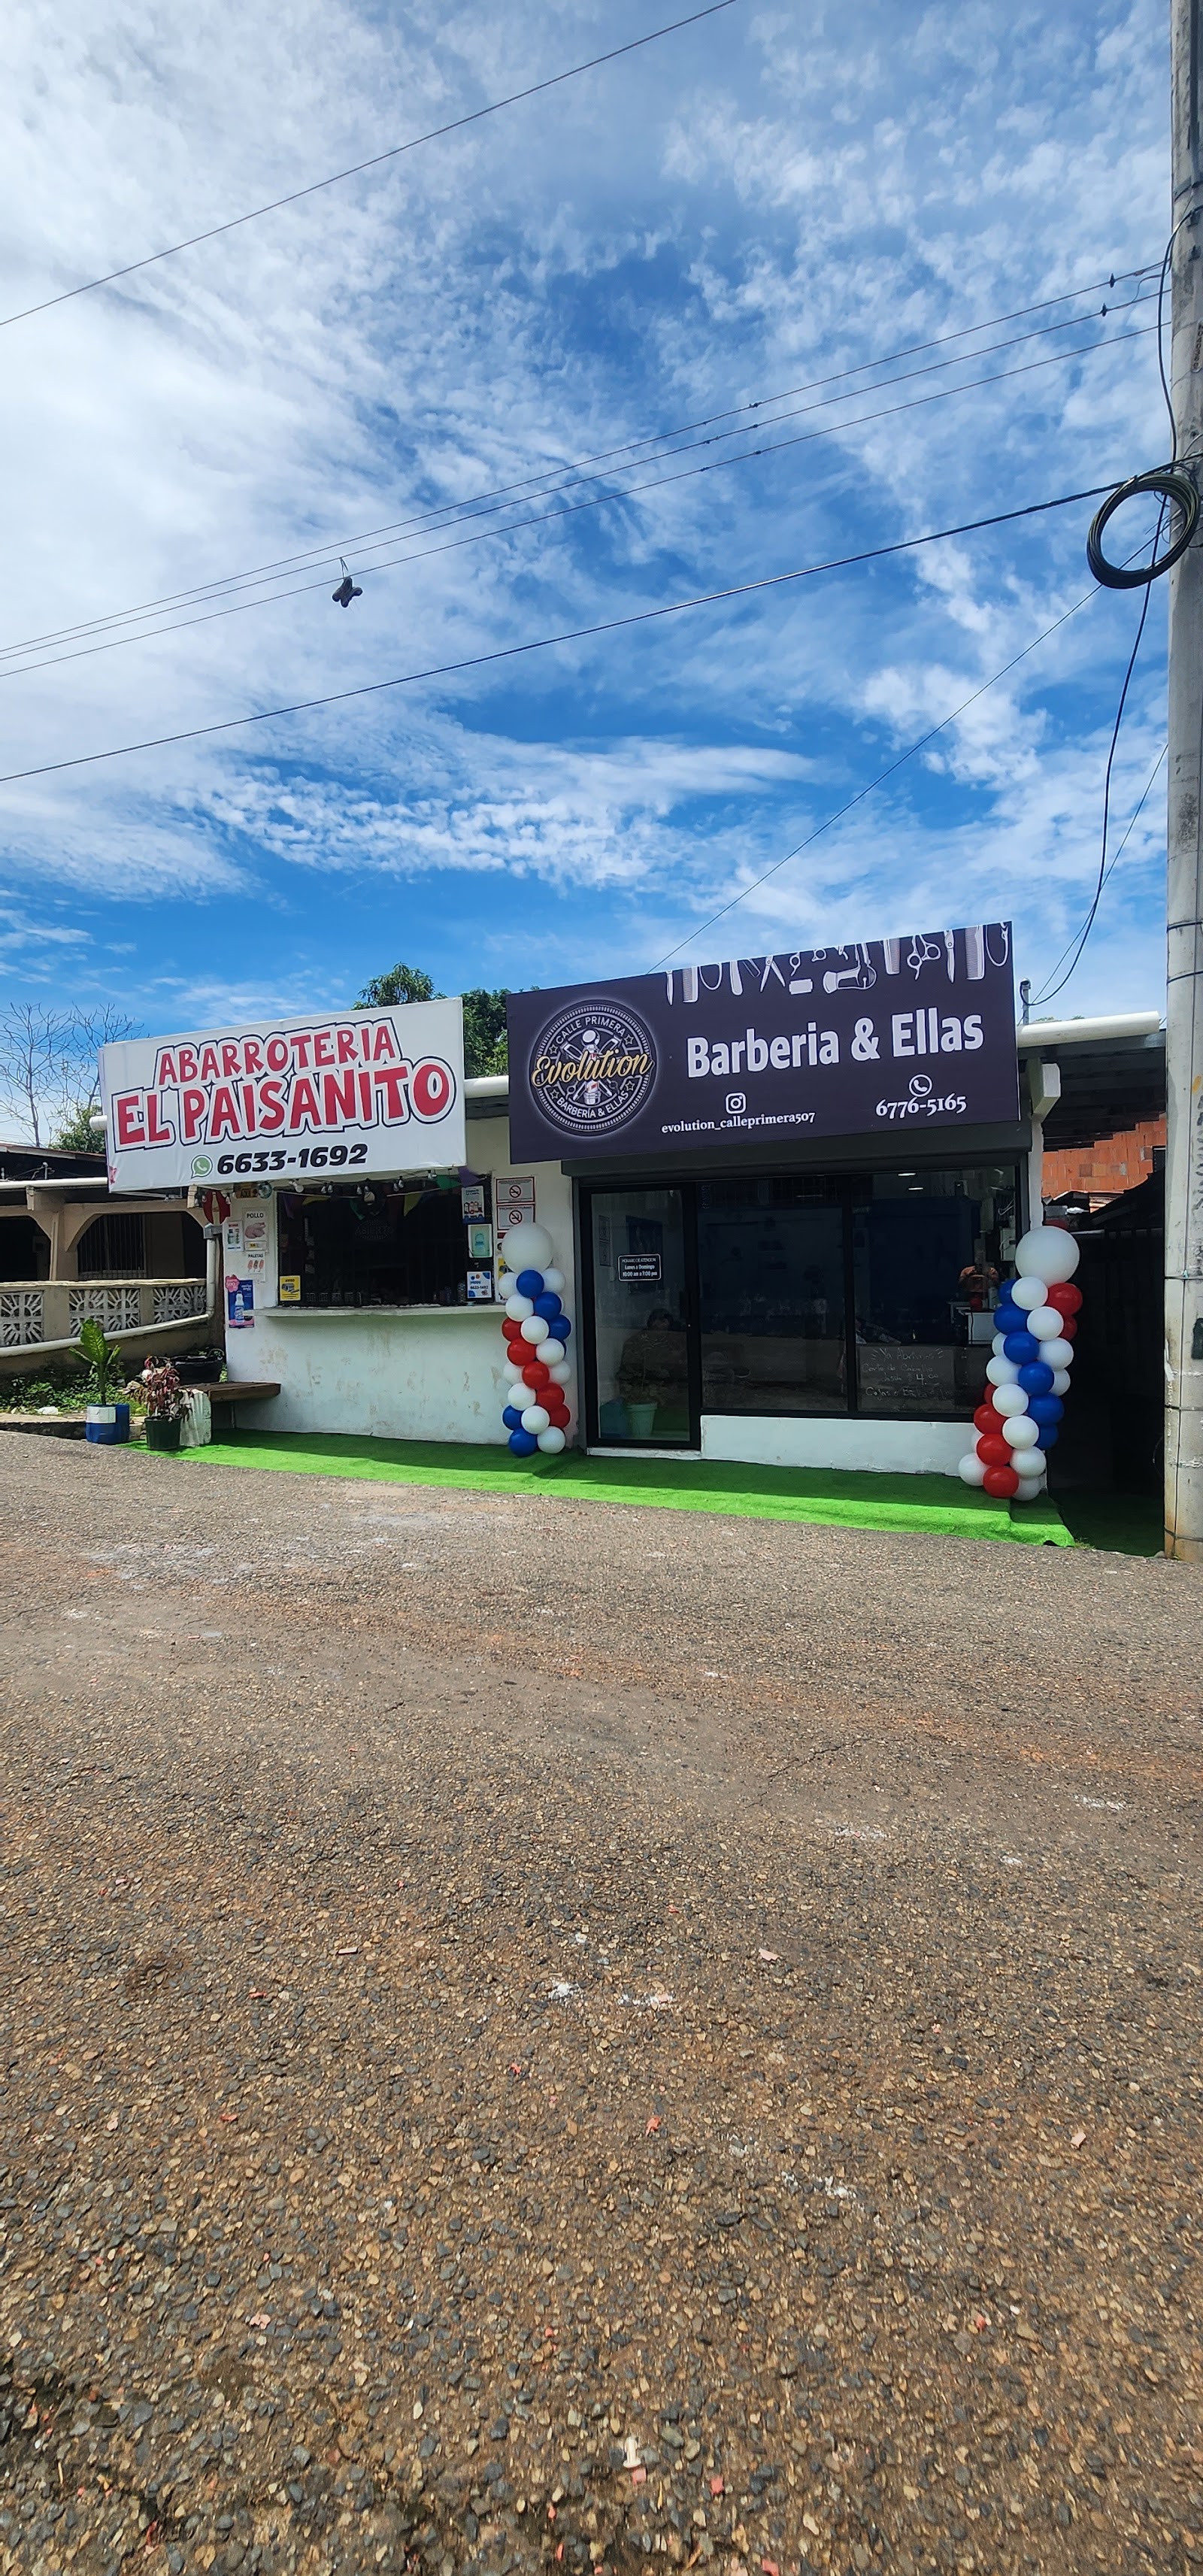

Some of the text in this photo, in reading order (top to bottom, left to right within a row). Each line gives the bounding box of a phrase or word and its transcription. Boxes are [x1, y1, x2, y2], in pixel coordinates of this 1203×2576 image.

[556, 1016, 626, 1044] CALLE PRIMERA
[687, 1007, 984, 1079] Barberia & Ellas
[158, 1026, 396, 1086] ABARROTERIA
[532, 1048, 654, 1087] Evolution
[117, 1064, 450, 1145] EL PAISANITO
[598, 1108, 605, 1117] &
[605, 1090, 629, 1111] ELLAS
[875, 1094, 967, 1120] 6776-5165
[661, 1111, 816, 1134] evolution_calleprimera507
[217, 1144, 368, 1175] 6633-1692
